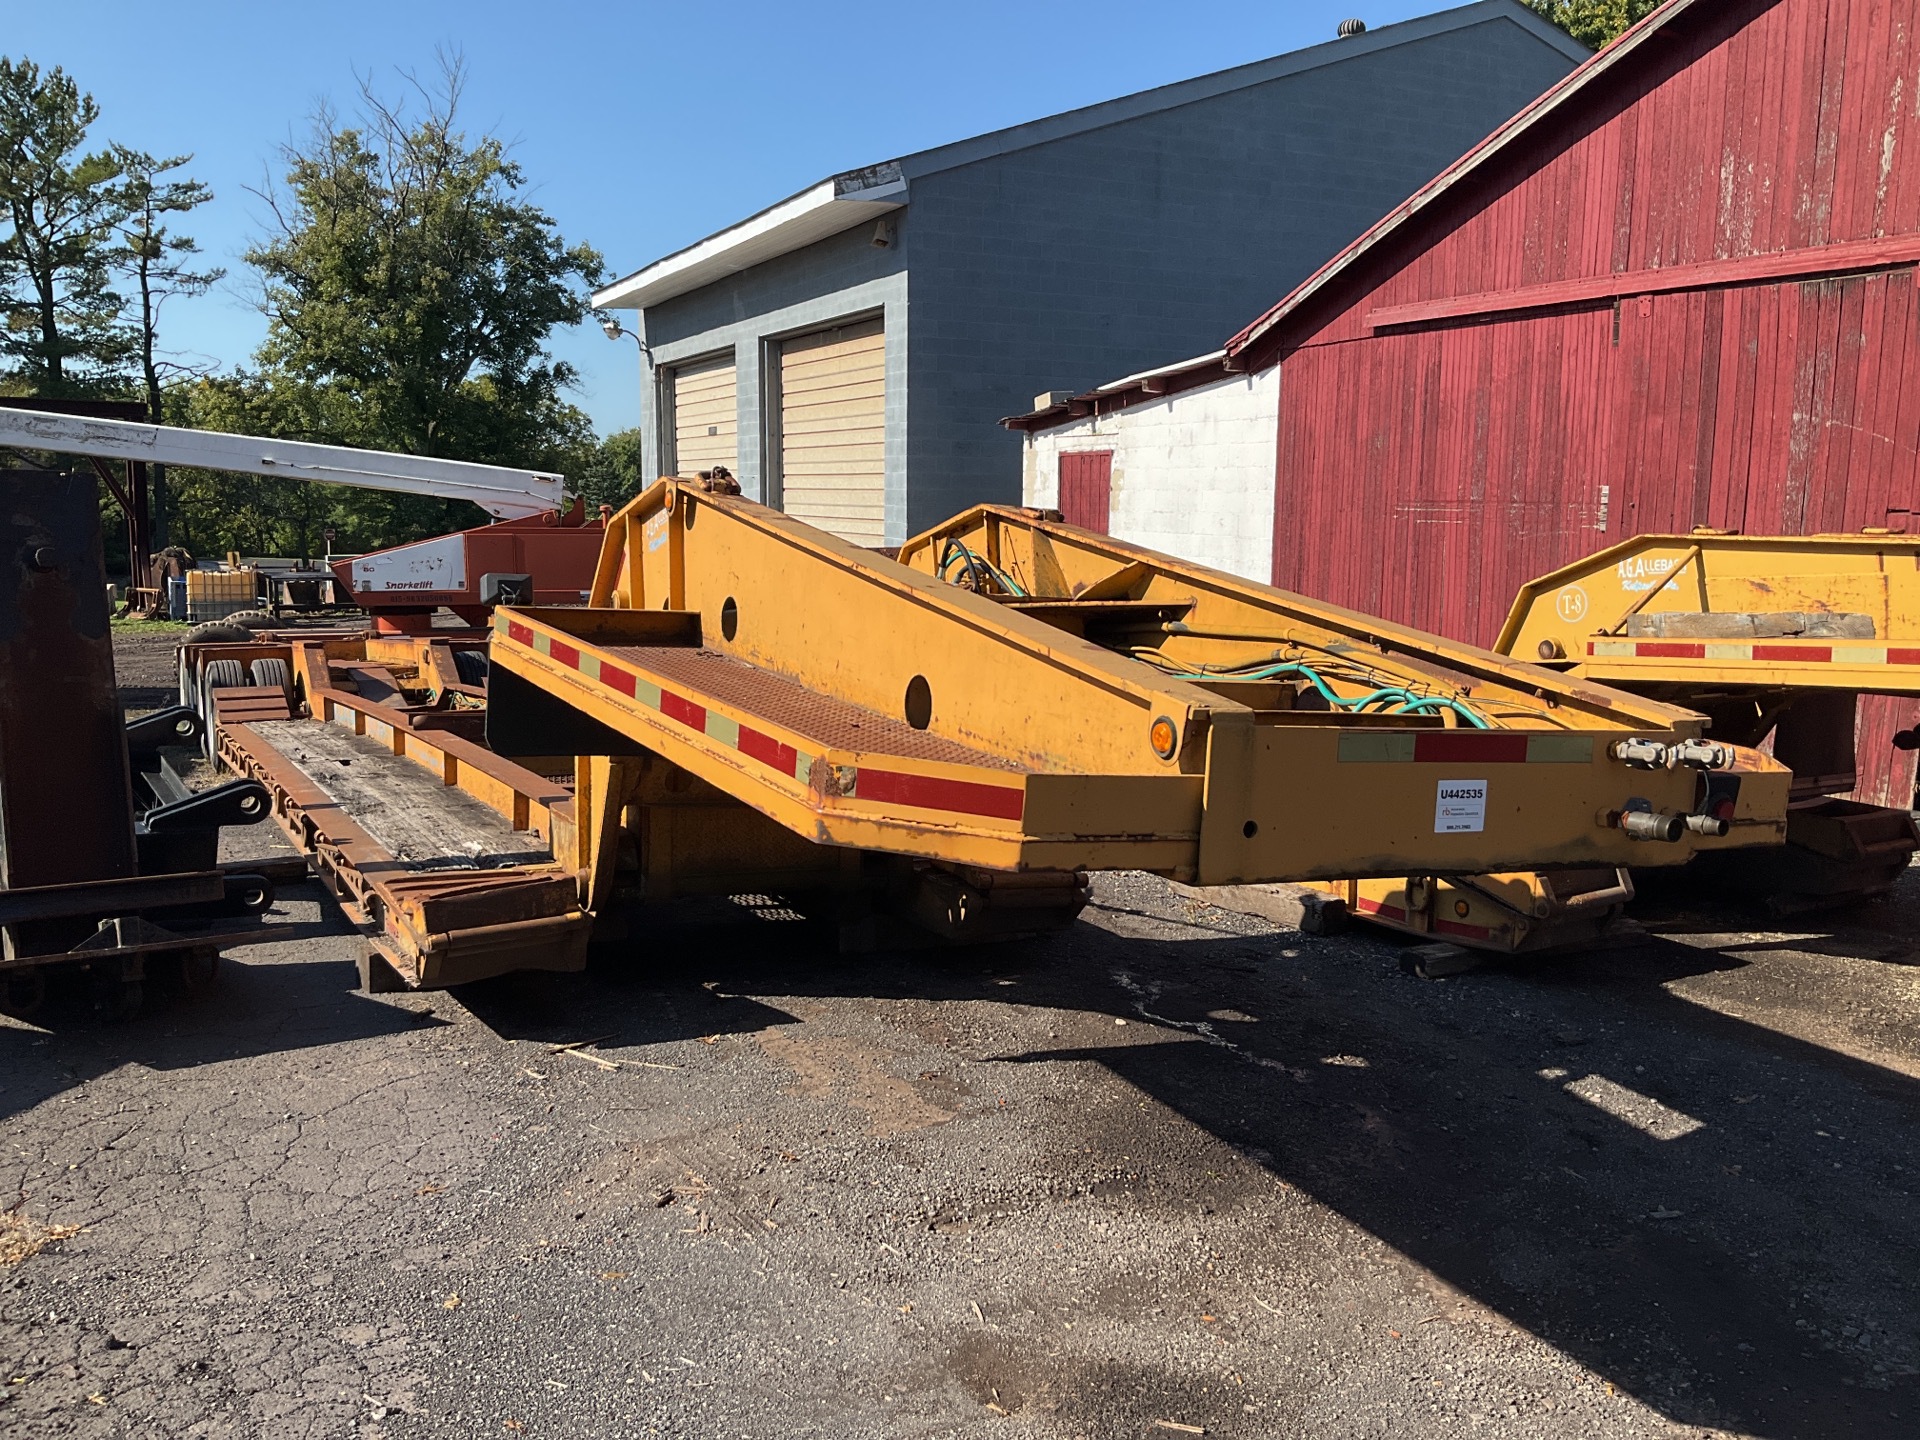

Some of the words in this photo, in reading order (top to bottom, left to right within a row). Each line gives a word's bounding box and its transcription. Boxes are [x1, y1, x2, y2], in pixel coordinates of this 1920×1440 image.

[1635, 558, 1687, 578] ALLEBA
[385, 581, 434, 590] Snorkelift
[1440, 789, 1483, 800] U442535
